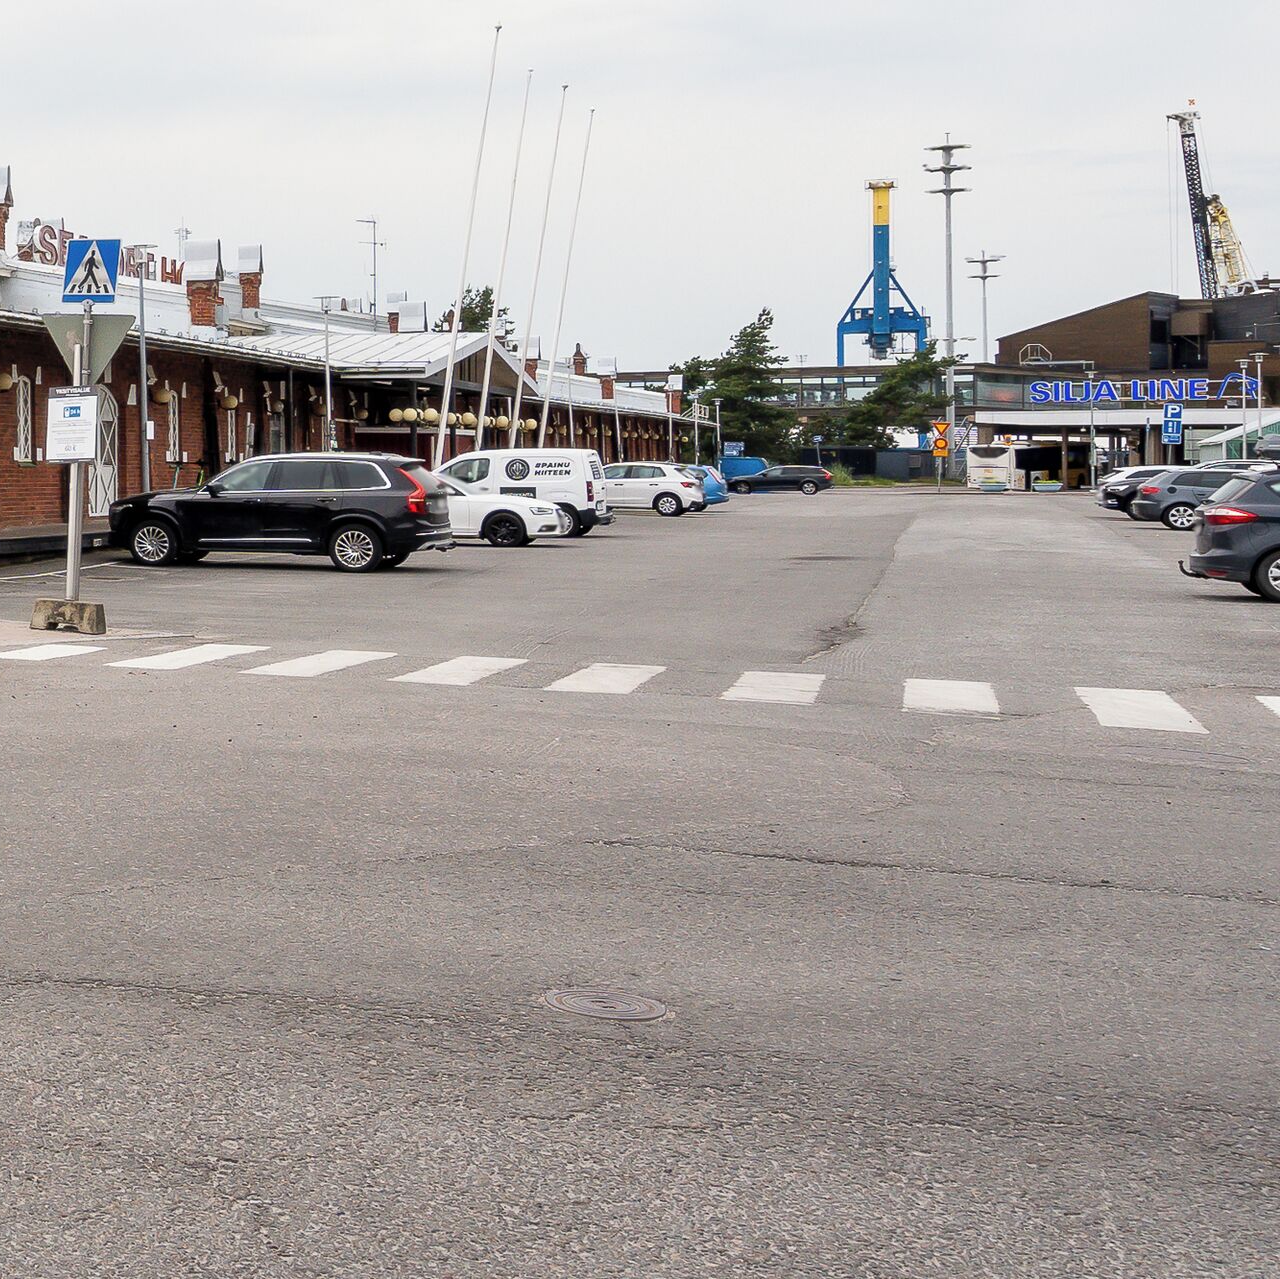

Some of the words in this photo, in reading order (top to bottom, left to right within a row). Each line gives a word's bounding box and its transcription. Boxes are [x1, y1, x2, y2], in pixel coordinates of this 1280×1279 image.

[1029, 378, 1120, 404] SILJA
[1131, 377, 1209, 401] LINE
[1167, 405, 1181, 418] P
